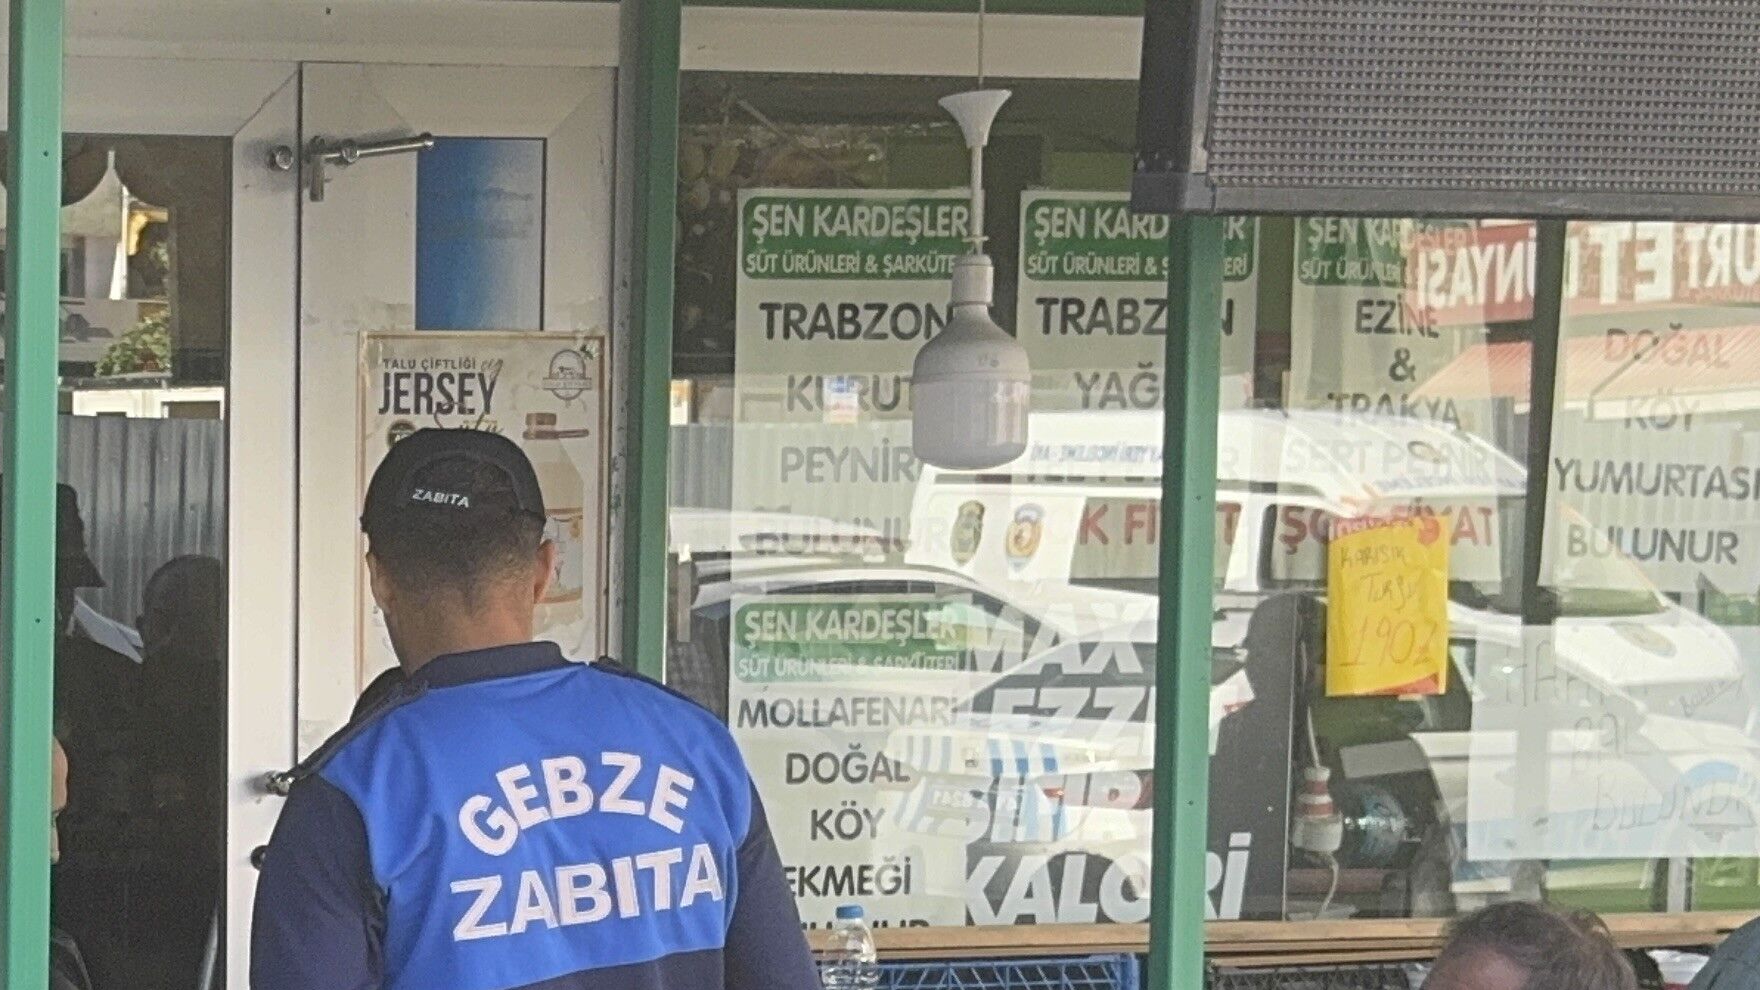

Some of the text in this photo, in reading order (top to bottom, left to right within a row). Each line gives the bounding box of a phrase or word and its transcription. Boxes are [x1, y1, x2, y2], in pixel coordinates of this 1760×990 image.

[752, 204, 969, 245] ŞEN KARDEŞLER
[1034, 206, 1085, 246] ŞEN
[746, 248, 956, 277] SÜT ÜRÜNLERİ & ŞARKÜTE
[1027, 251, 1058, 275] SÜT
[1063, 250, 1139, 276] ÜRÜNLERİ
[1144, 257, 1158, 275] &
[759, 302, 953, 341] TRABZON
[1035, 297, 1234, 336] TRABZN
[383, 358, 416, 370] TALU
[1389, 347, 1417, 383] &
[378, 371, 497, 416] JERSEY
[412, 488, 470, 509] ZABITA
[1566, 524, 1739, 565] BULUNUR
[744, 610, 797, 650] ŞEN
[785, 742, 910, 785] DOĞAL
[458, 751, 695, 856] GEBZE
[810, 800, 885, 841] KÖY
[450, 843, 723, 942] ZABITA
[783, 856, 911, 898] EKMEĞİ
